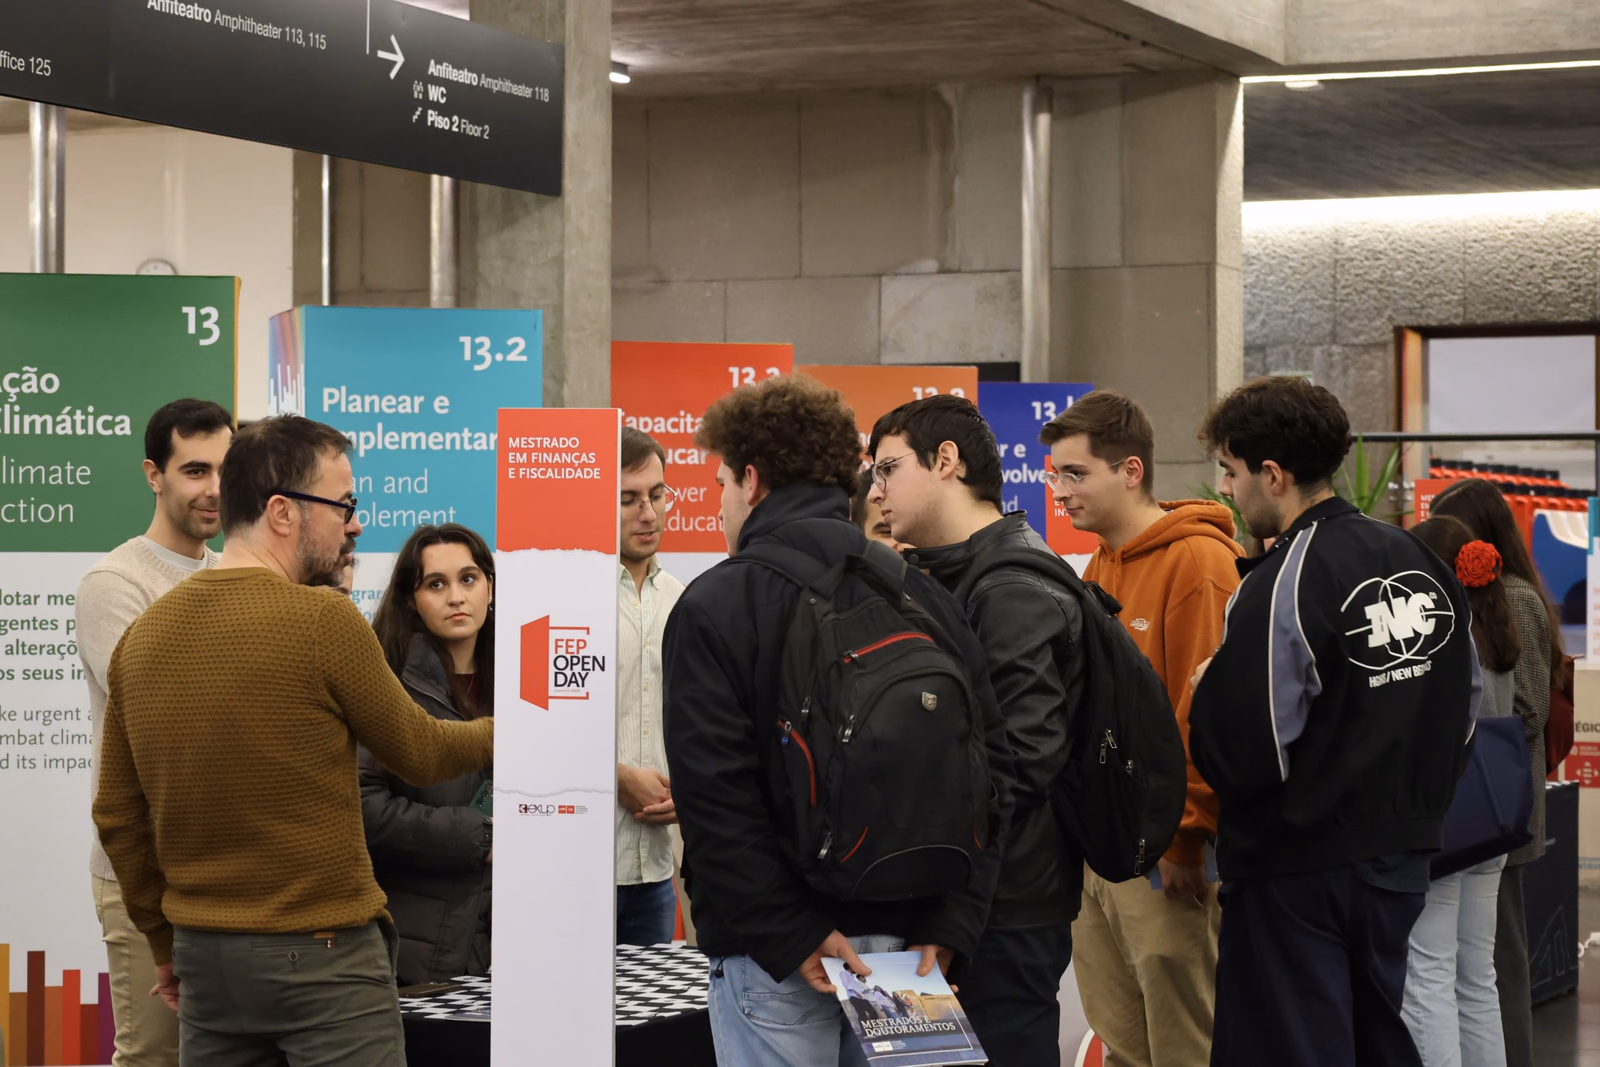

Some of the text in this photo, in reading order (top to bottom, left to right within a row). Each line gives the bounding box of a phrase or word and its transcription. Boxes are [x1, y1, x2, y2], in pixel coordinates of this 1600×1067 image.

[213, 9, 282, 40] Amphitheater
[284, 26, 306, 48] 113,
[308, 32, 327, 50] 115
[29, 56, 51, 77] 125
[428, 58, 550, 103] Anfiteatro Amphitheater 118
[427, 83, 447, 104] WC
[427, 109, 490, 140] Piso 2 Floor 2
[182, 306, 220, 346] 13
[459, 336, 528, 371] 13.2
[0, 366, 60, 402] ção
[322, 385, 451, 415] Planear e
[0, 404, 132, 436] limática
[508, 436, 580, 449] MESTRADO
[1013, 443, 1027, 459] e
[508, 452, 597, 467] EM FINANÇAS
[384, 468, 428, 494] and
[508, 467, 601, 479] E FISCALIDADE
[554, 638, 588, 655] FEP
[553, 654, 606, 672] OPEN
[22, 668, 65, 681] seus
[554, 671, 590, 688] DAY
[23, 707, 82, 727] urgent
[17, 754, 37, 770] its
[861, 1014, 932, 1029] MESTRADOS E
[865, 1022, 956, 1037] DOUTORAMENTOS
